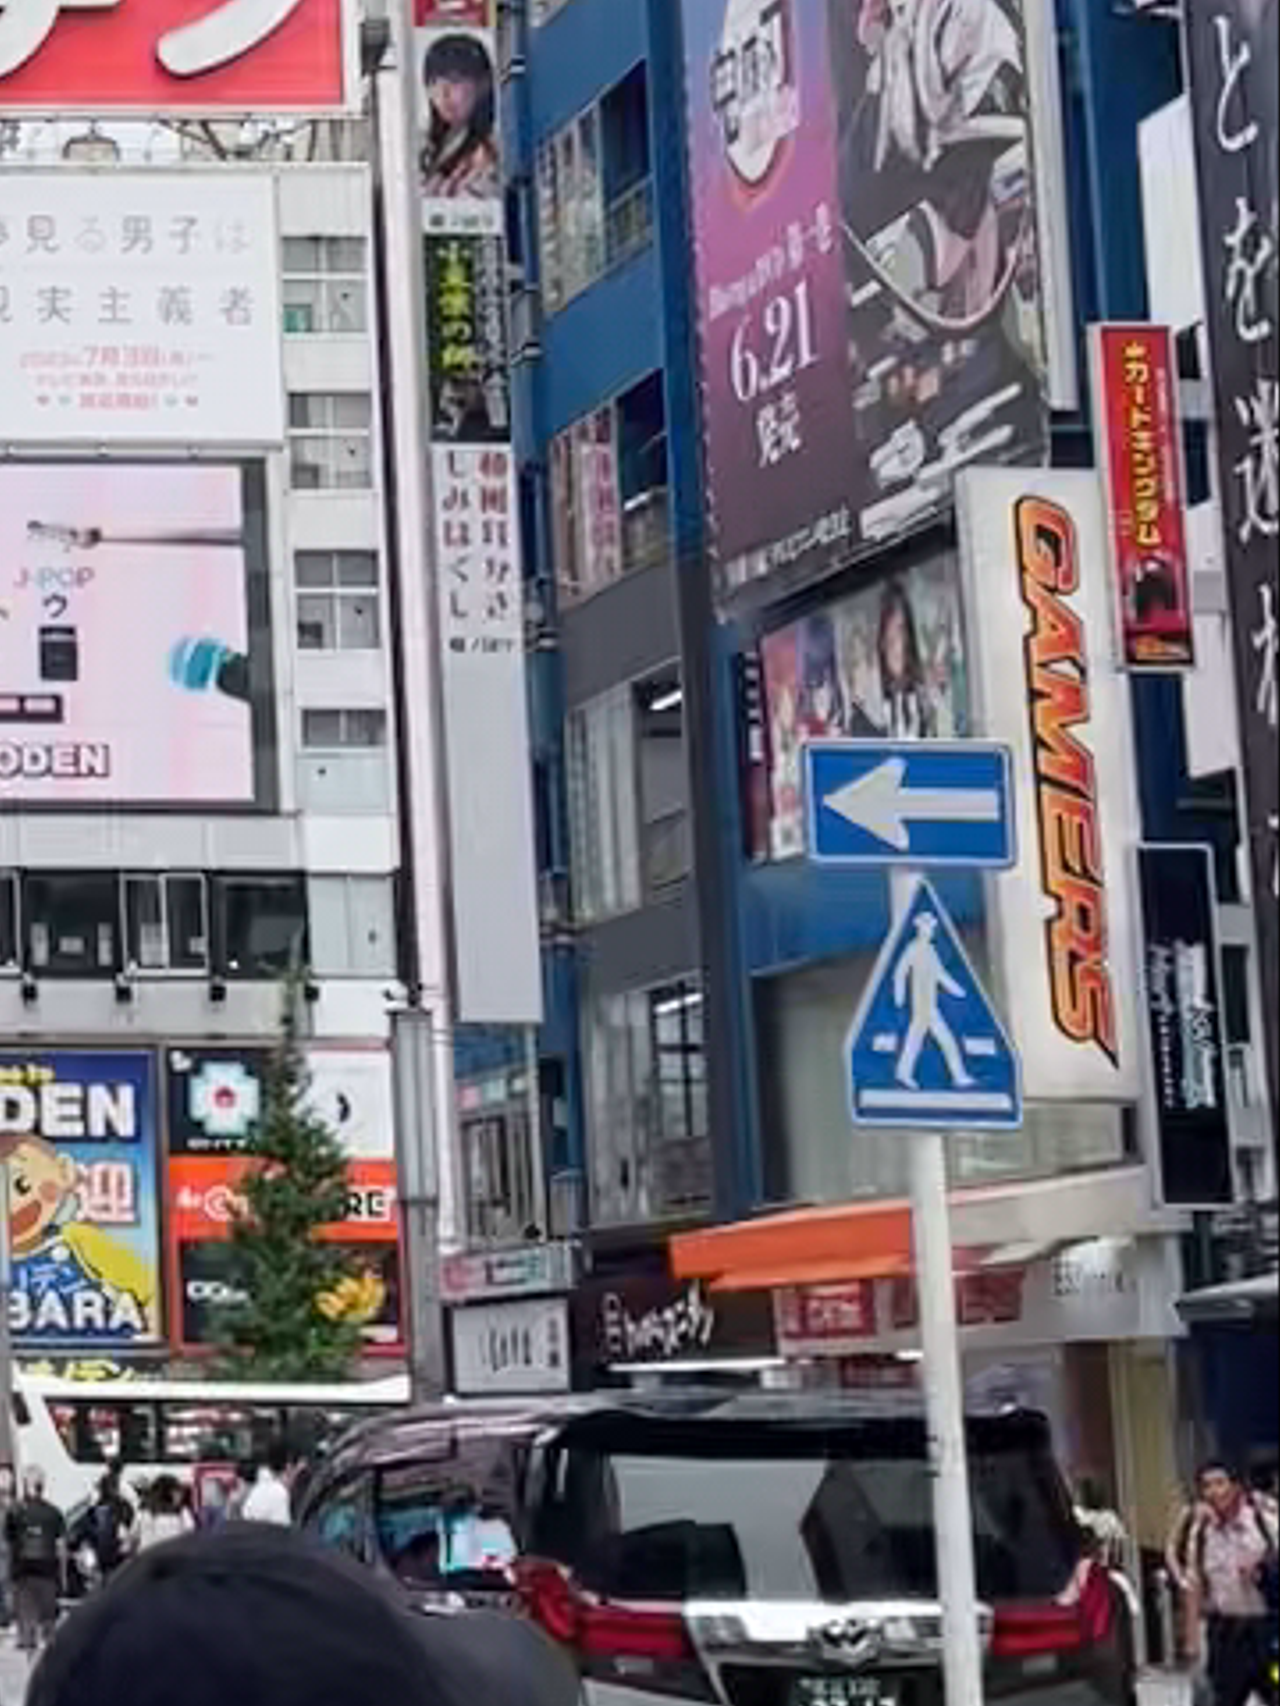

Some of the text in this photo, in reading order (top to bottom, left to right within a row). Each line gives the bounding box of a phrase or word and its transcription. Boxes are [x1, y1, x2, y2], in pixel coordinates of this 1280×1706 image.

[726, 270, 820, 424] 6.21
[1013, 494, 1120, 1068] GAMERS
[30, 1062, 56, 1080] to
